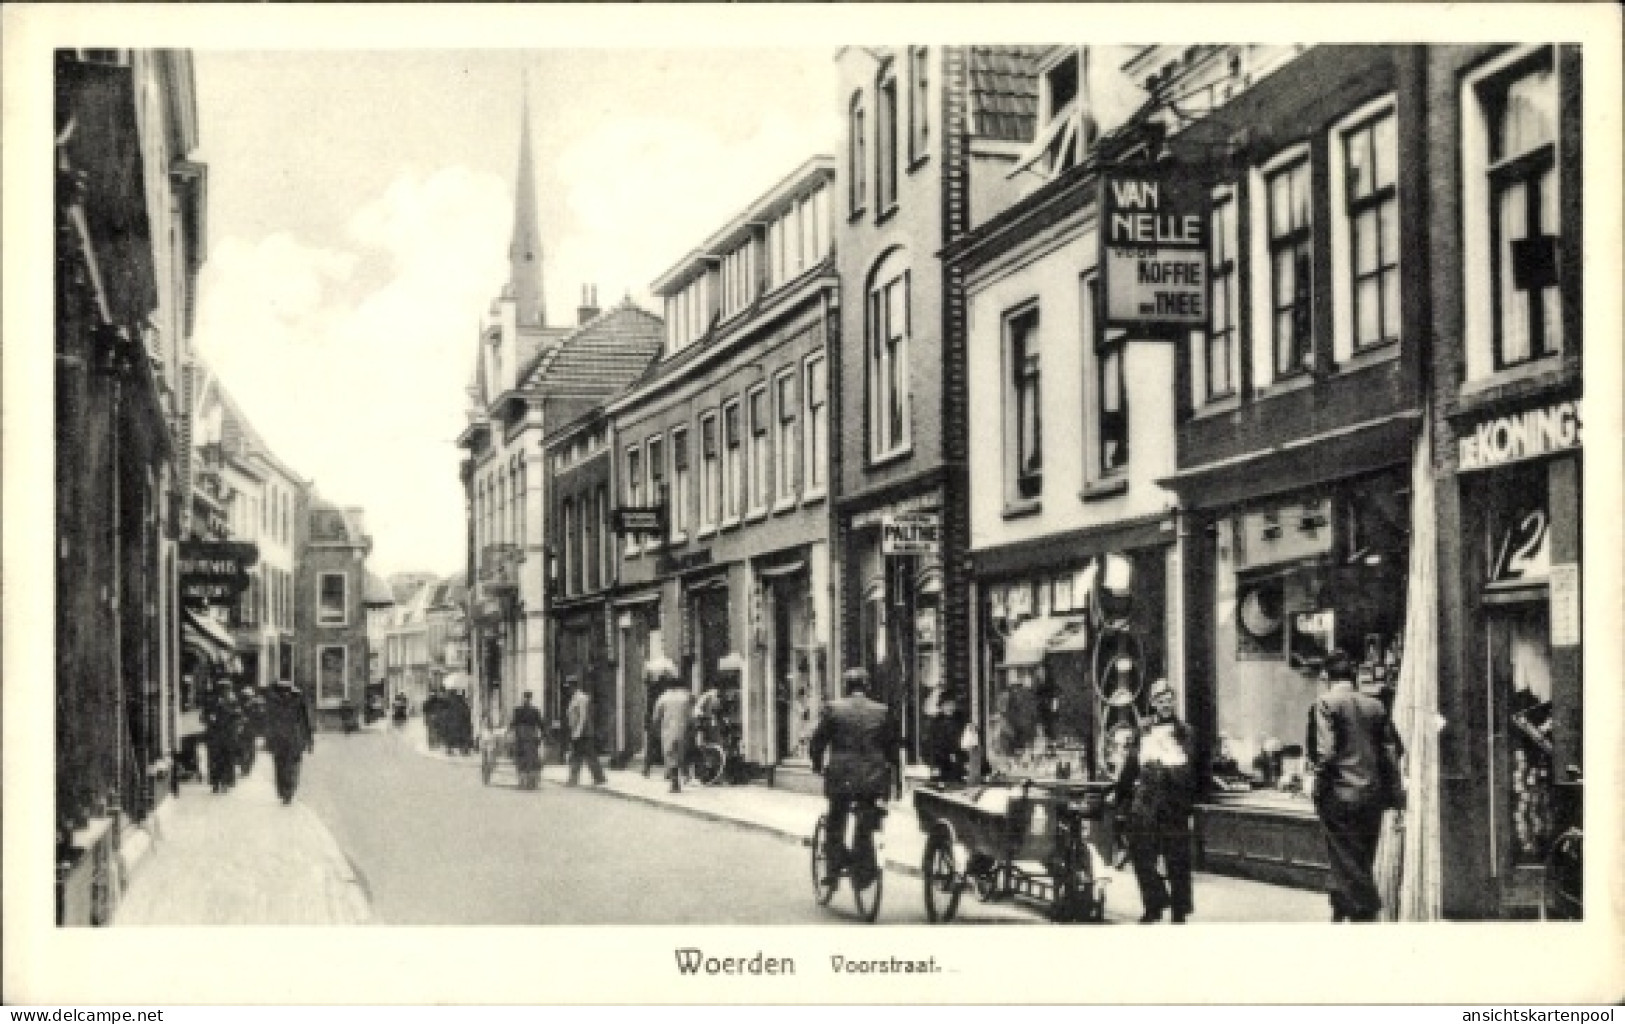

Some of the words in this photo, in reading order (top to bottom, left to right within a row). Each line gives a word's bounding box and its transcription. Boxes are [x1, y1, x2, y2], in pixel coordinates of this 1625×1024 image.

[1112, 179, 1158, 210] VAN
[1112, 213, 1200, 244] NELLE
[1138, 261, 1202, 284] KOFFIE
[1155, 291, 1202, 315] THEE
